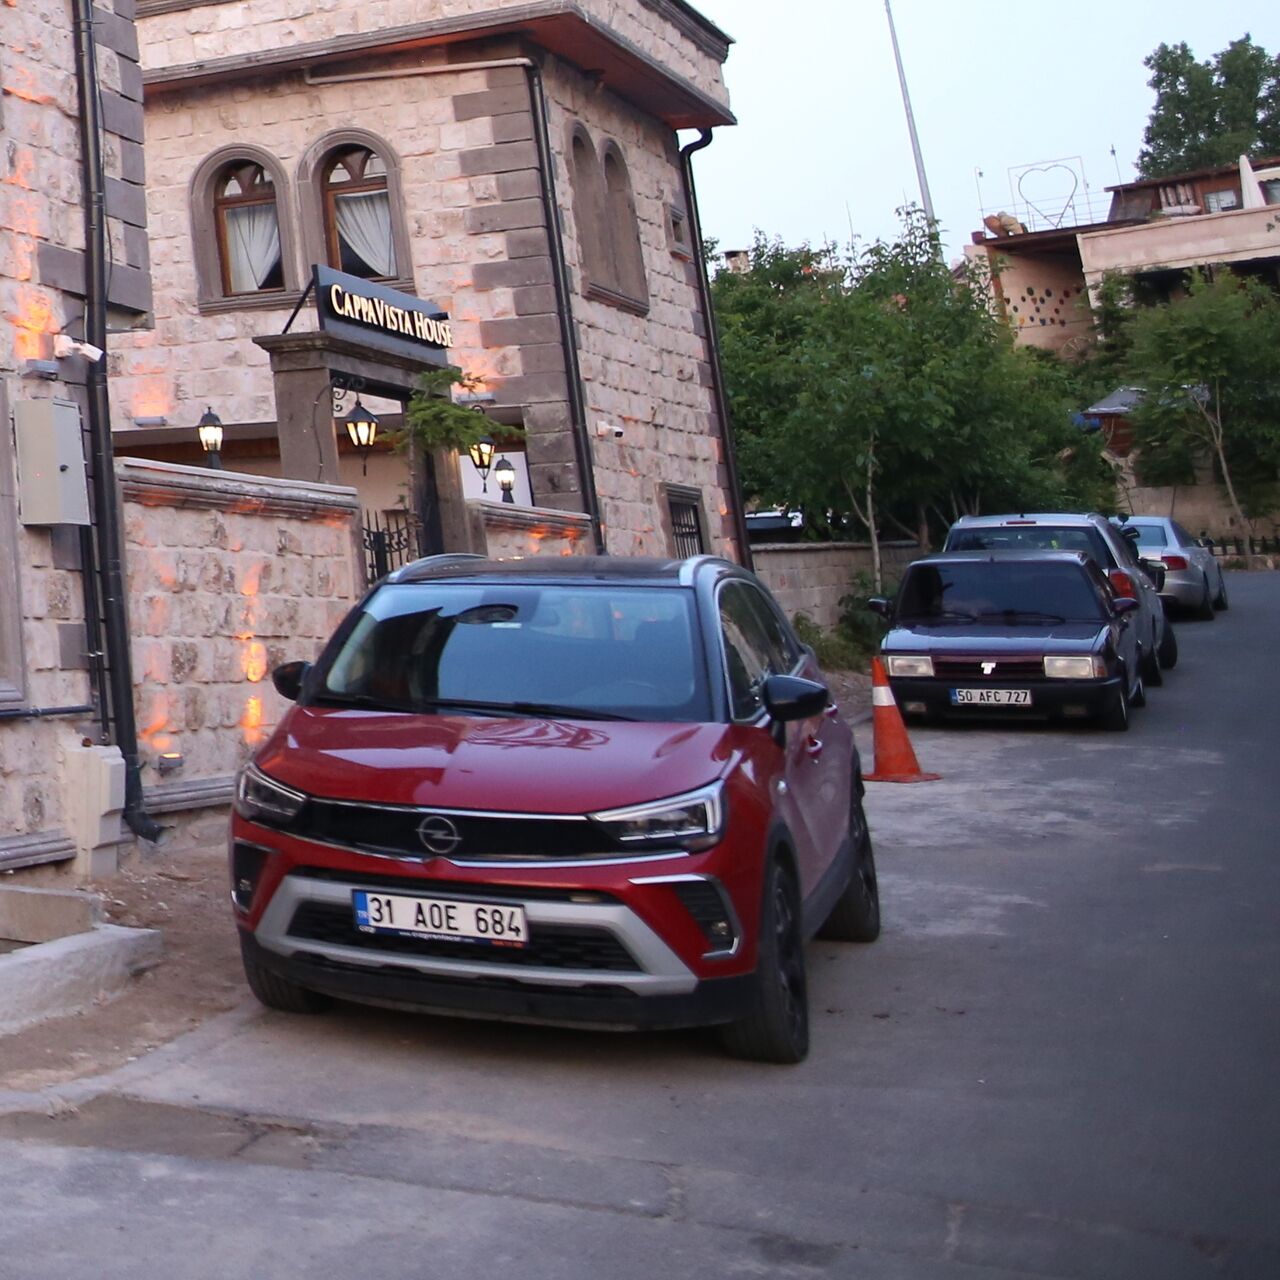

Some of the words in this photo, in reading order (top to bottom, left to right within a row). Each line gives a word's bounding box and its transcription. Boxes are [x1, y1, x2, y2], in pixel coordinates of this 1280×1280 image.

[413, 311, 453, 347] HOUSE
[957, 690, 973, 702] 50
[979, 691, 1001, 702] AFC
[1005, 691, 1028, 703] 727
[370, 897, 394, 924] 31
[415, 902, 458, 931] AOE
[475, 907, 521, 937] 684
